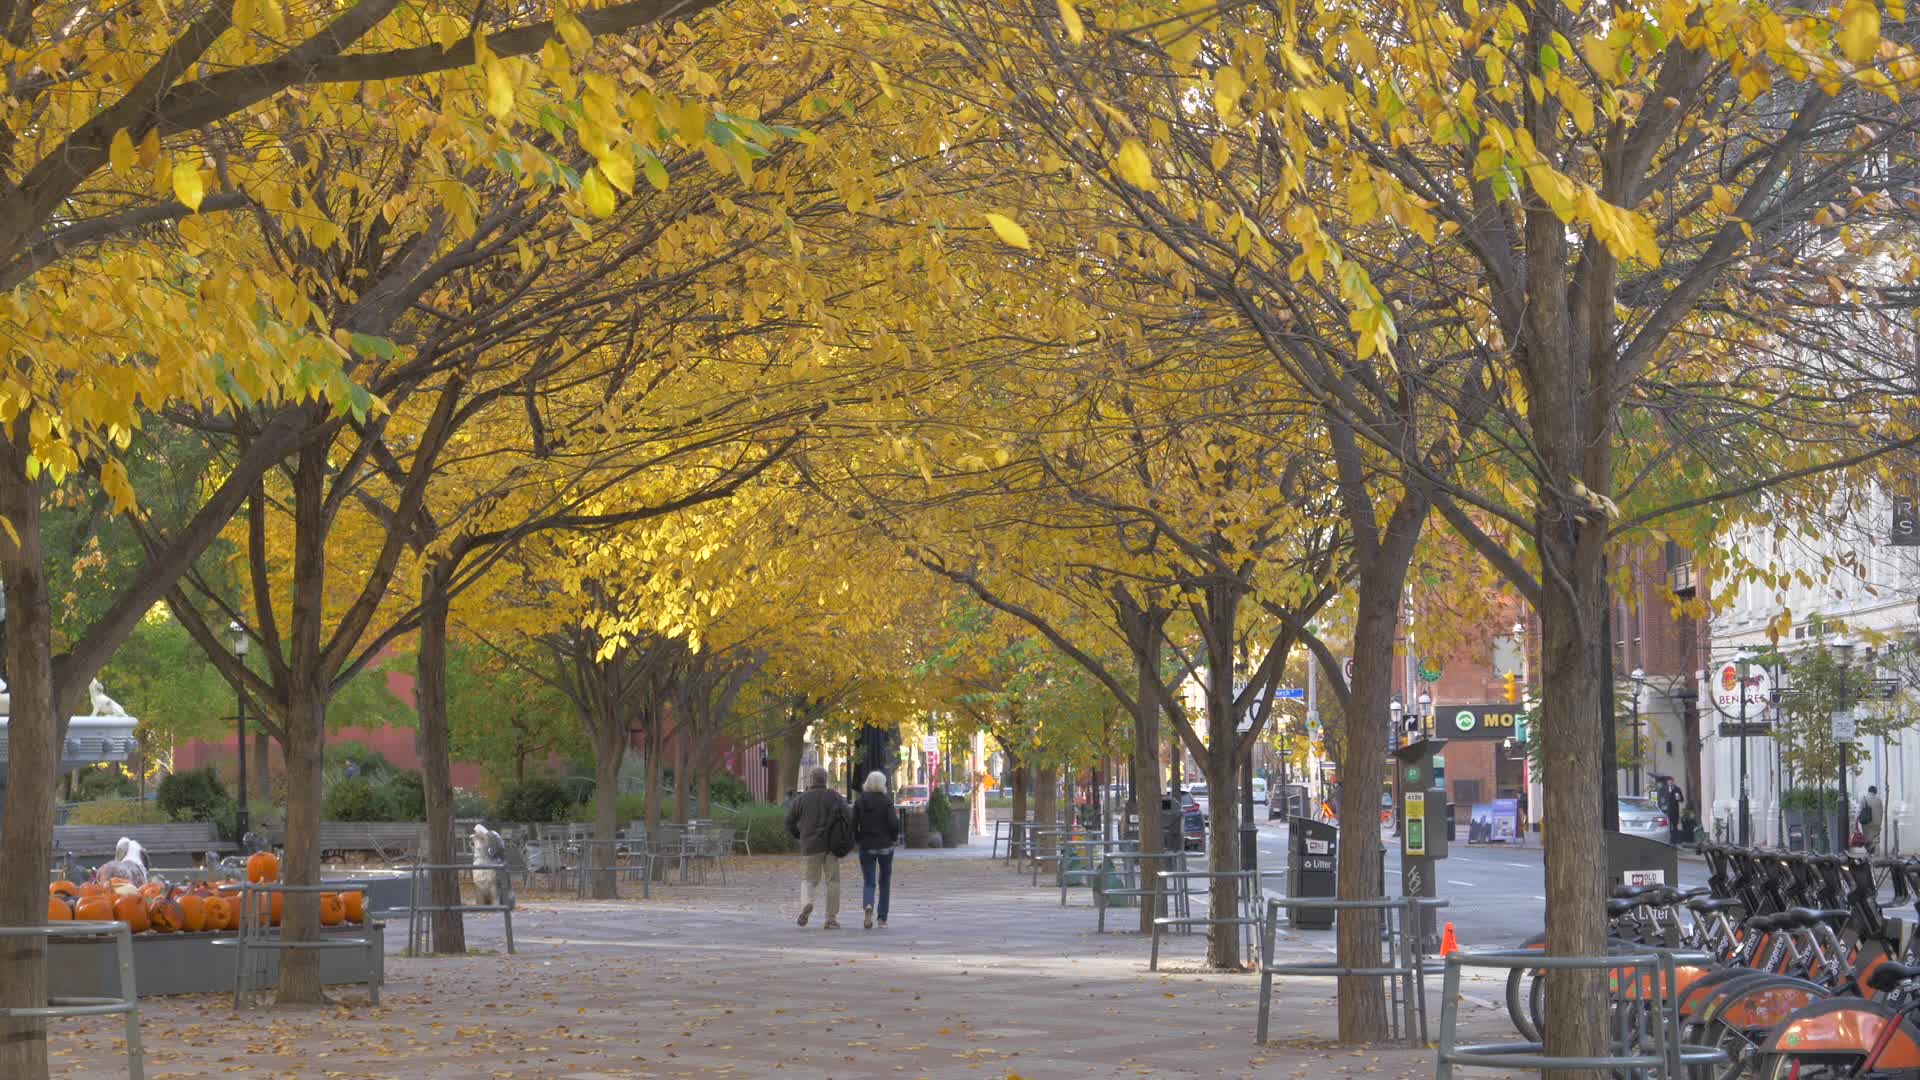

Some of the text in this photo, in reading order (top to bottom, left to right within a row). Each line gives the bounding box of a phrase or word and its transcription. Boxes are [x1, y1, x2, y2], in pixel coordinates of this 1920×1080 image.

[1719, 695, 1765, 704] BENRE
[1313, 860, 1332, 869] Litter
[1639, 905, 1668, 920] Liter
